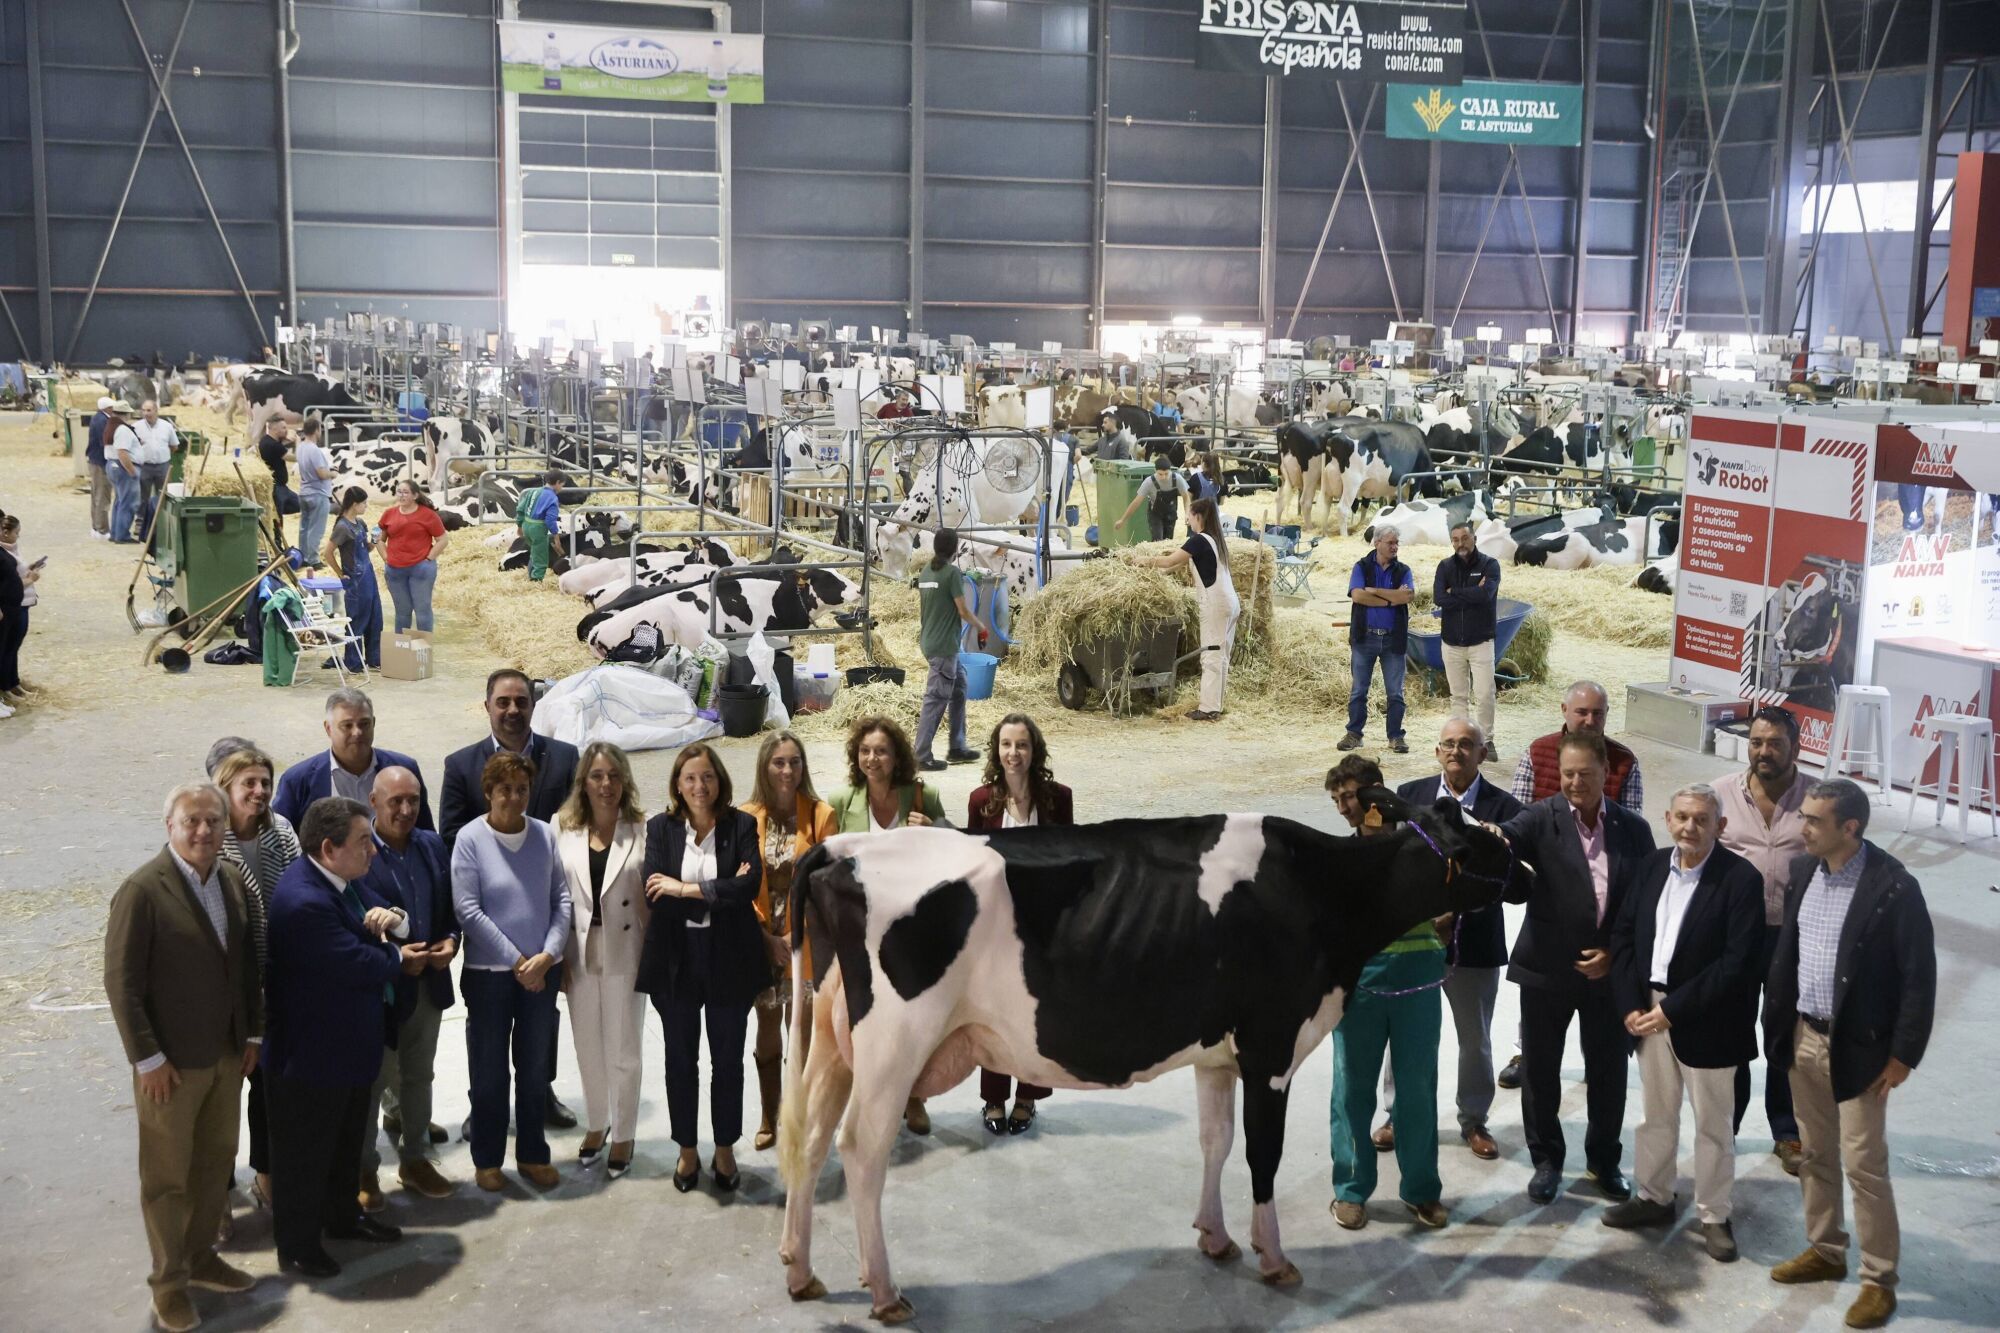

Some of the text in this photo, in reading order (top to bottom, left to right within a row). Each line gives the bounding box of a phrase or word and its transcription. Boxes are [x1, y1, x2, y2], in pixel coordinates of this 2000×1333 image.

[1201, 0, 1363, 37] FRISONA
[1400, 15, 1432, 32] www.
[1366, 31, 1463, 53] revistafrisona.com
[1260, 30, 1362, 75] Española
[1385, 53, 1444, 73] conafe.com
[1460, 98, 1560, 119] CAJA RURAL
[1460, 119, 1533, 133] DE ASTURIAS
[1721, 459, 1767, 476] NANTA Dairy
[1913, 462, 1953, 477] NANTA
[1719, 470, 1768, 493] Robot
[1694, 503, 1739, 518] El programa
[1693, 514, 1736, 528] de nutrición
[1692, 525, 1753, 543] y asesoramiento
[1691, 536, 1745, 552] para robots de
[1690, 547, 1717, 559] ordeño
[1690, 558, 1724, 571] de Nanta
[1893, 562, 1944, 578] NANTA
